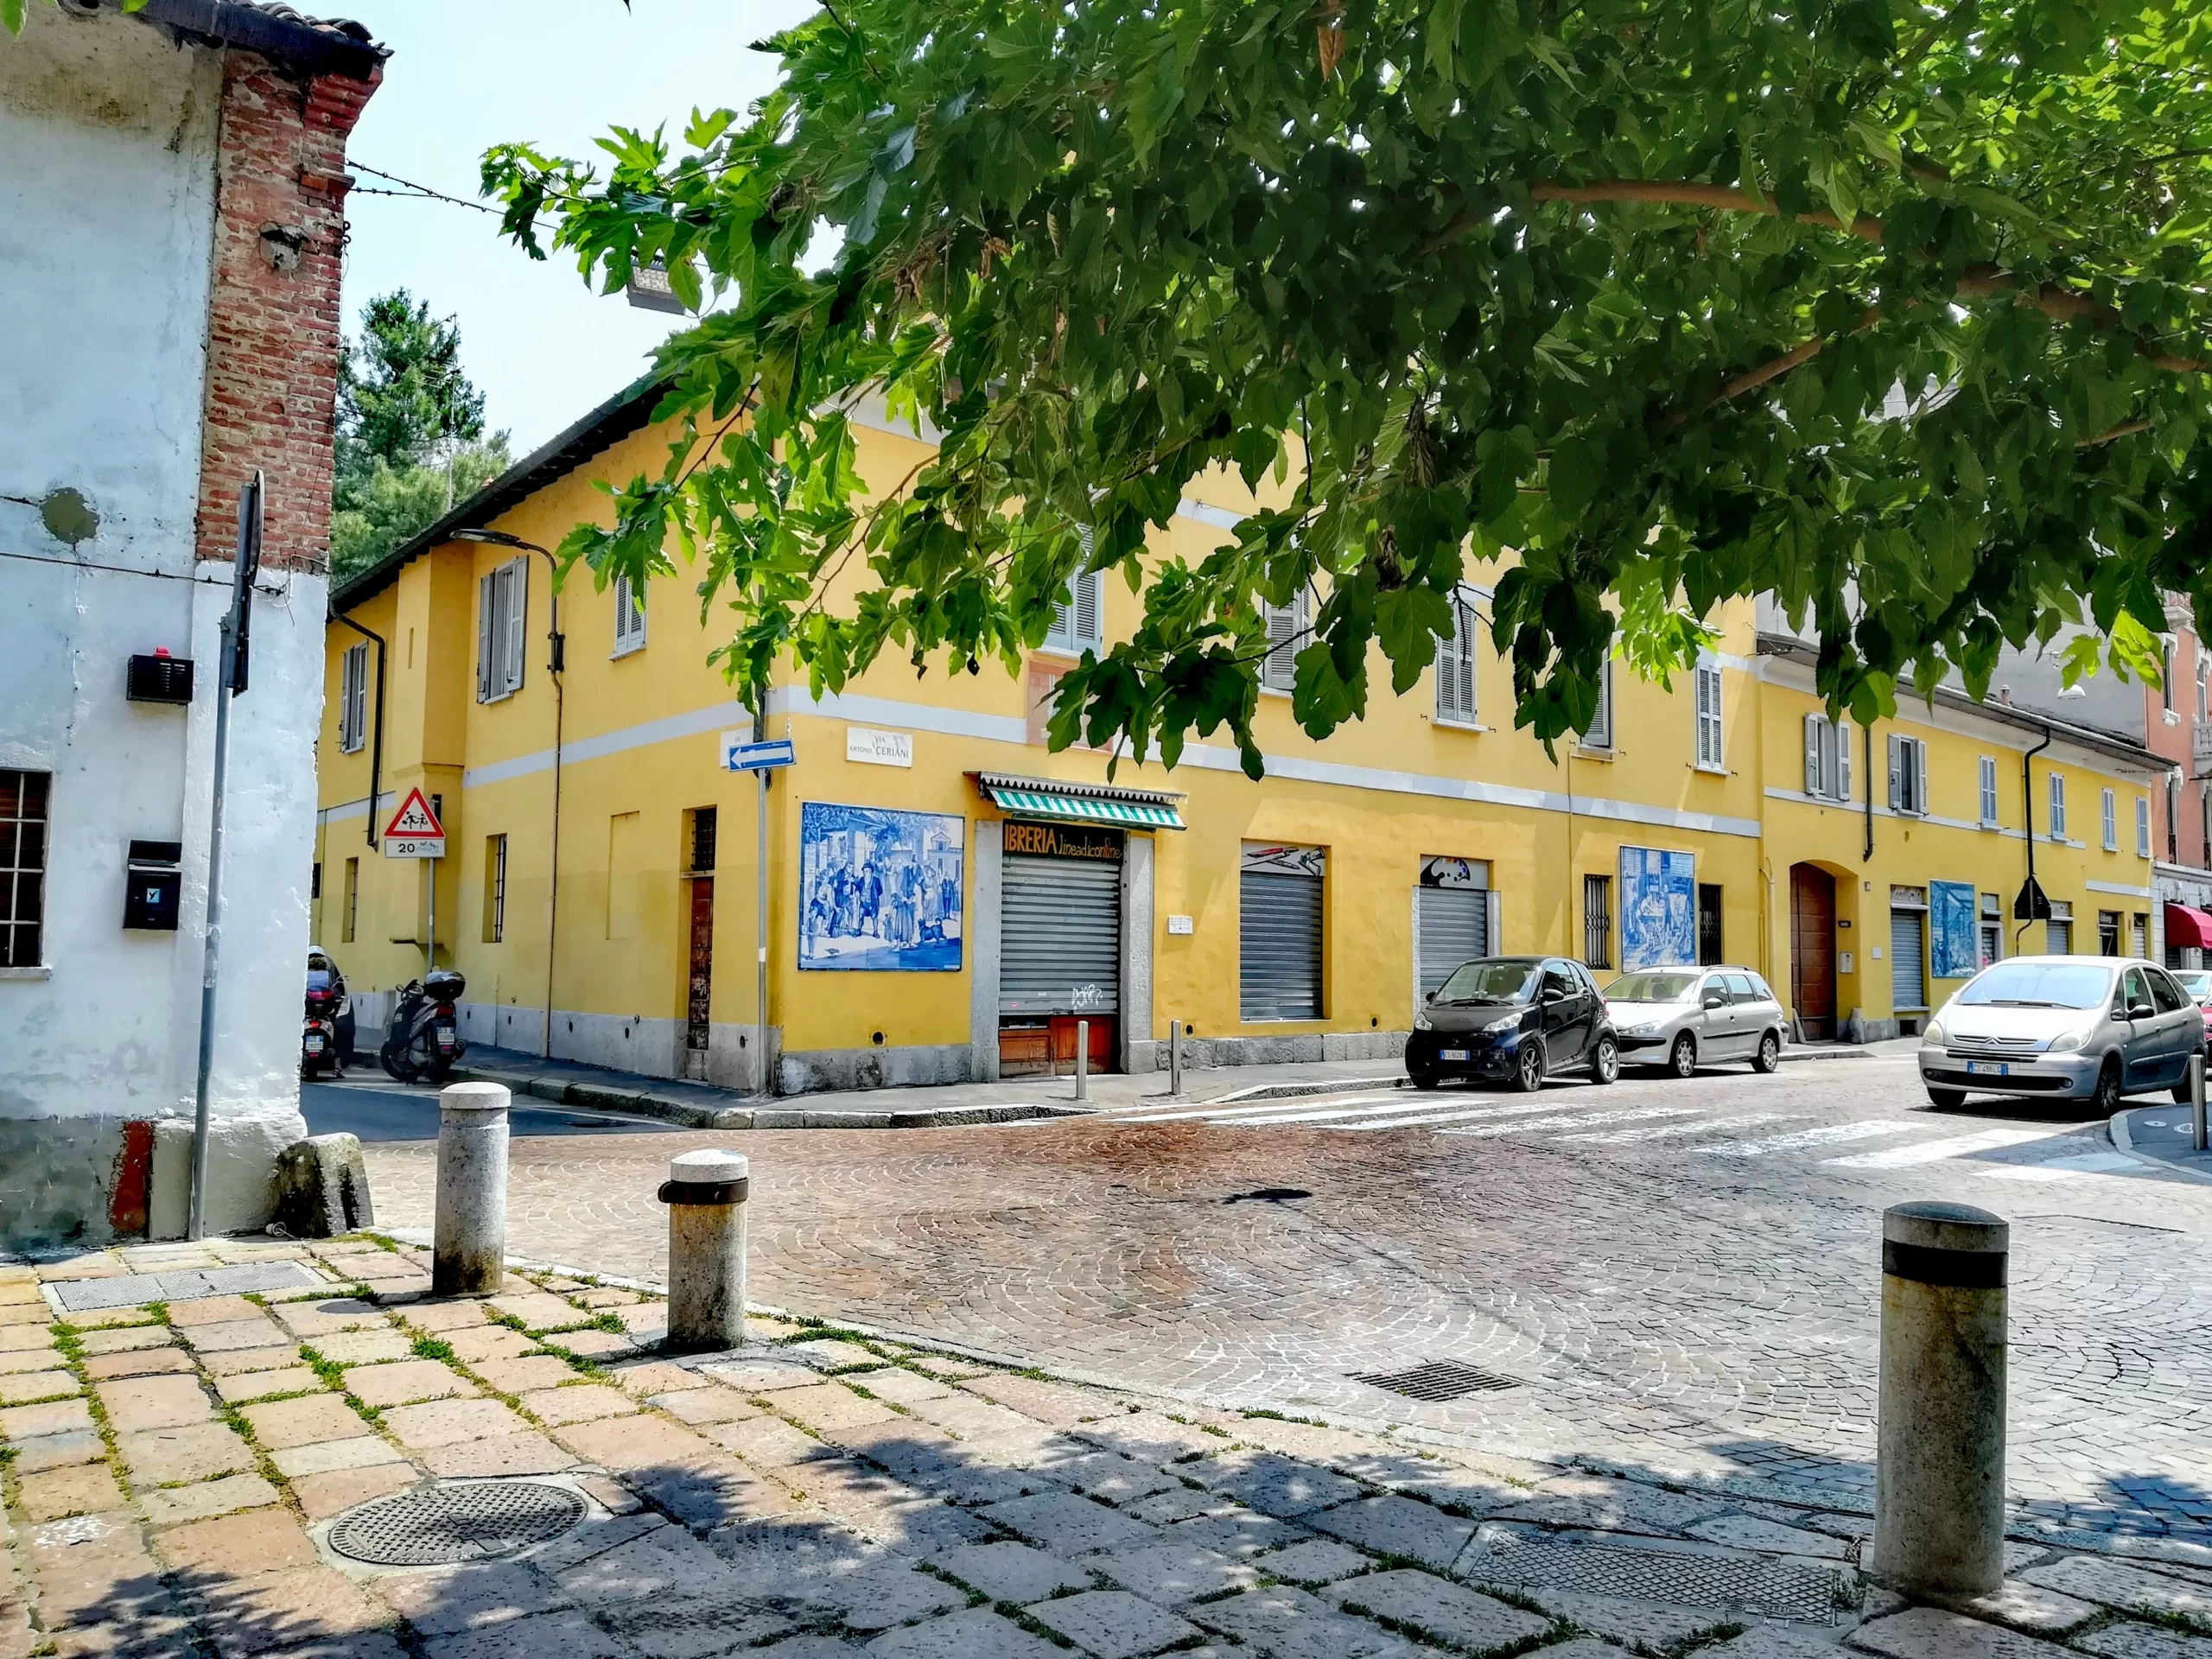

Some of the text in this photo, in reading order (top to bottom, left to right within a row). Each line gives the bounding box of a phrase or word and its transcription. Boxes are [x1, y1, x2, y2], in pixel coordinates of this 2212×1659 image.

[874, 735, 887, 744] VIA
[849, 745, 909, 759] ANTONIO CERIANI
[1004, 823, 1058, 855] IBRERIA
[398, 842, 416, 853] 20
